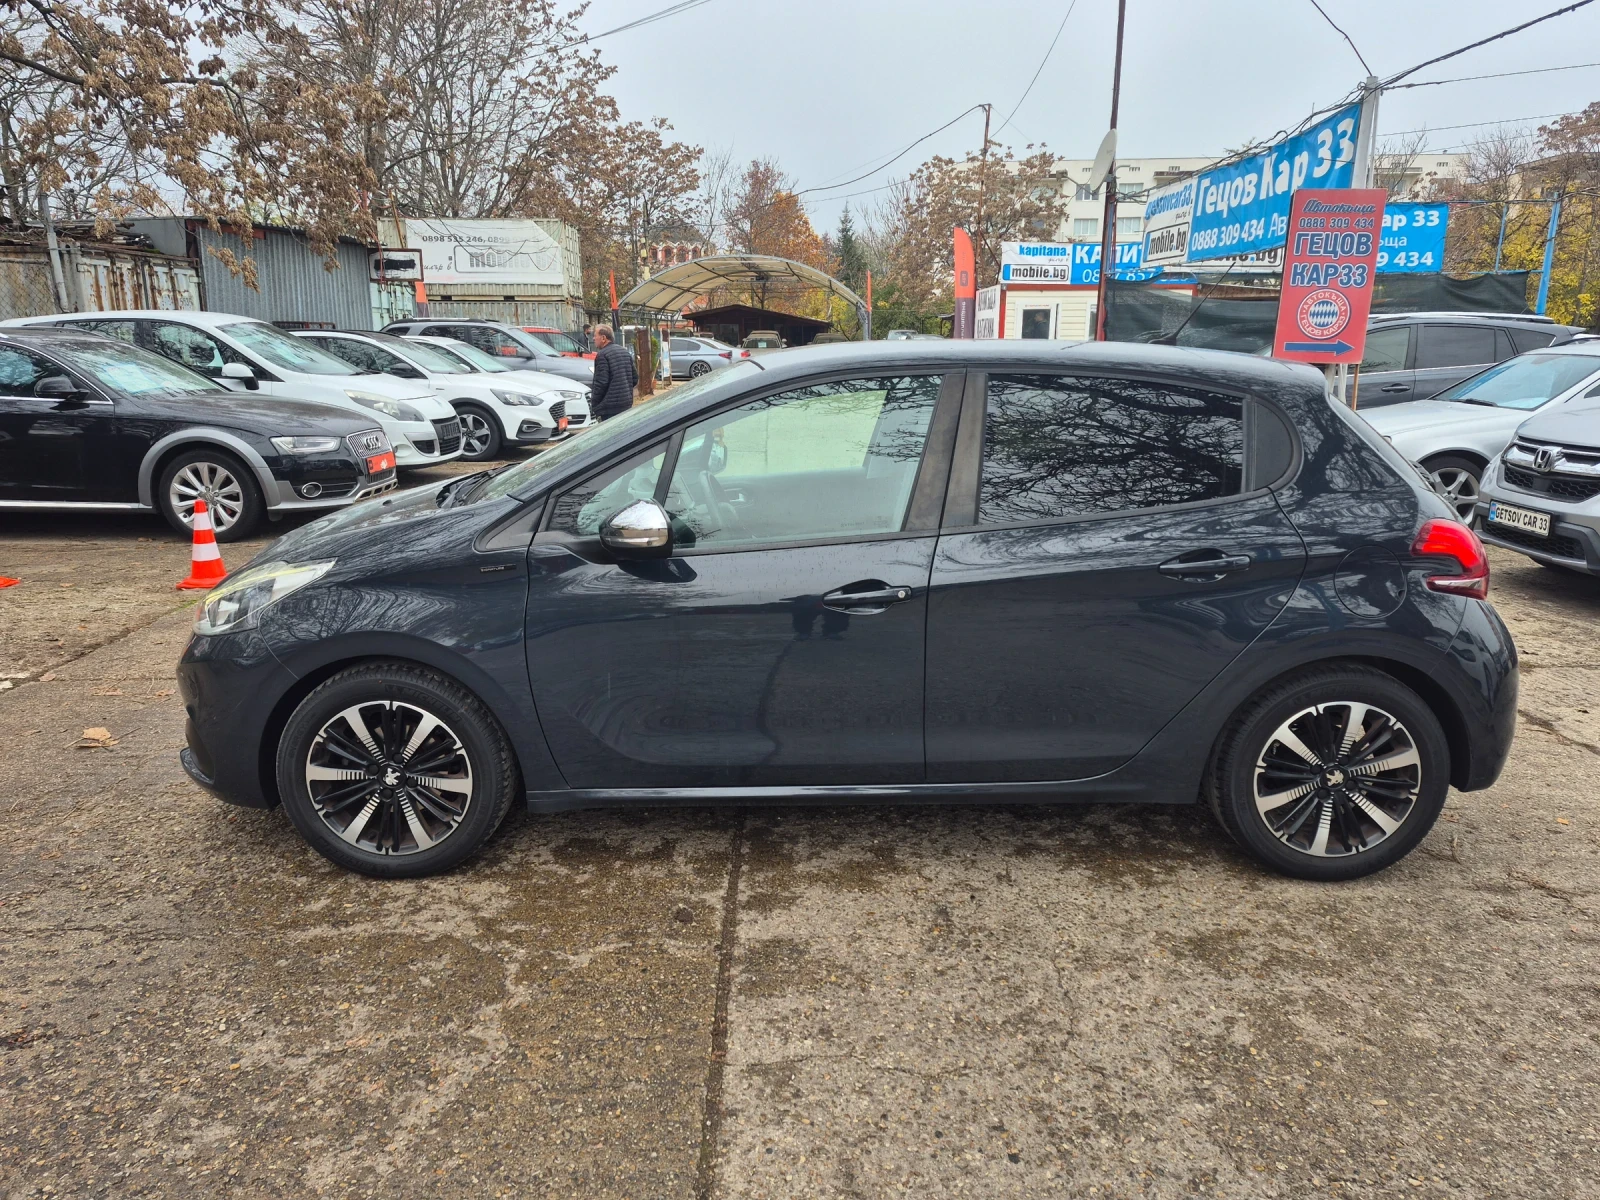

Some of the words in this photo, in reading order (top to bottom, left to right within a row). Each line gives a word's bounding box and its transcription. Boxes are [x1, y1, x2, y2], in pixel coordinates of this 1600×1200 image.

[1196, 172, 1259, 218] Гецов
[1260, 151, 1309, 200] Кар
[1313, 118, 1355, 178] 33
[1192, 227, 1217, 251] 0888
[1219, 225, 1240, 247] 309
[1241, 218, 1265, 242] 434
[1267, 212, 1288, 239] Ав
[1298, 216, 1325, 229] 0888
[1329, 216, 1350, 229] 309
[1353, 216, 1374, 229] 434
[1382, 213, 1407, 231] ар
[1412, 210, 1440, 227] 33
[1148, 228, 1187, 255] mobile.bg
[1294, 231, 1373, 260] ГЕЦОВ
[1393, 251, 1434, 267] 434
[1012, 266, 1066, 279] mobile.bg
[1290, 262, 1369, 288] КАР33
[1302, 291, 1347, 311] АВТОКЪЩА
[1300, 315, 1322, 336] ГЕЦОВ
[1495, 507, 1523, 523] GETSOV
[1523, 513, 1538, 528] CAR
[1539, 518, 1548, 531] 33
